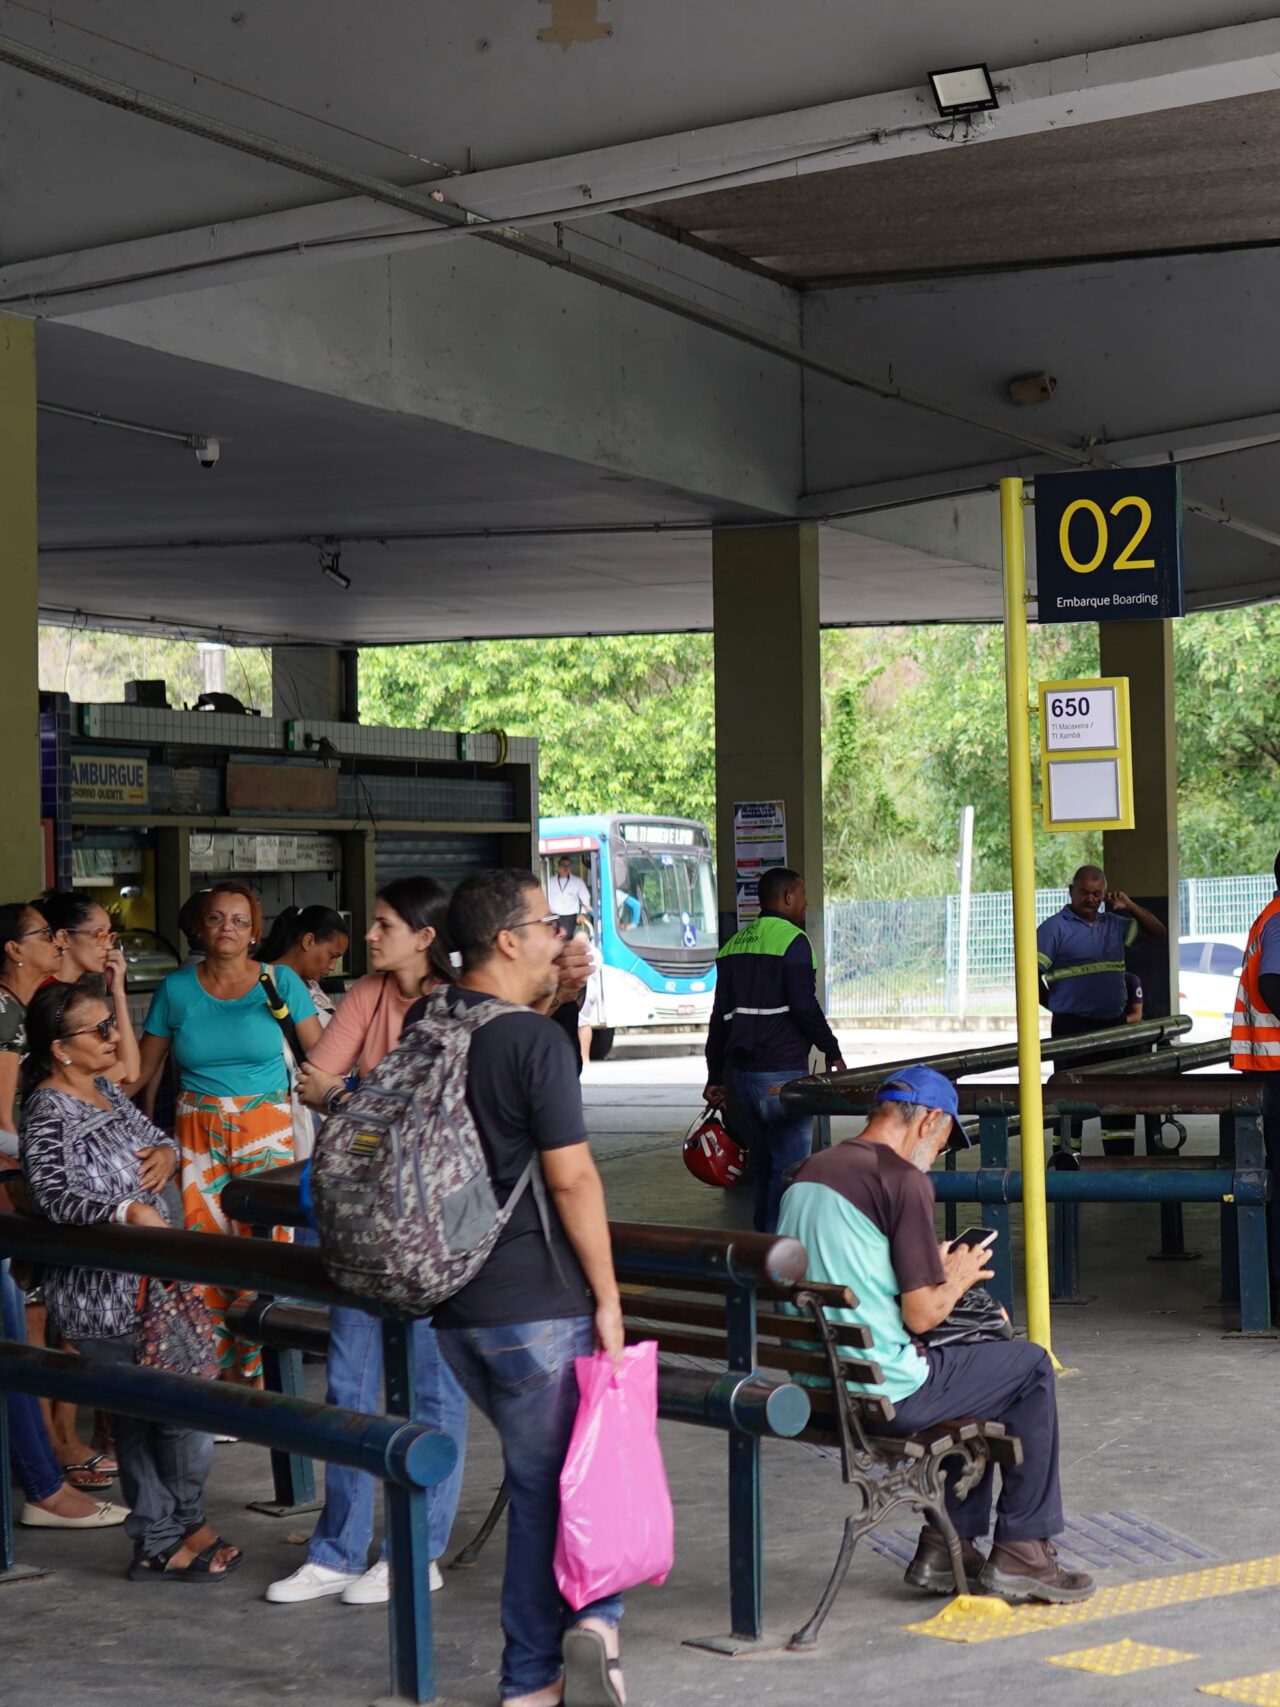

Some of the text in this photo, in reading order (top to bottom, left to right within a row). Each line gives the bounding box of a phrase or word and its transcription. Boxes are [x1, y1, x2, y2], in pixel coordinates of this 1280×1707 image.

[1059, 496, 1155, 573] 02
[1056, 593, 1159, 608] Embarque Boarding
[1051, 697, 1090, 718] 650
[1051, 723, 1058, 731] TI
[1059, 722, 1089, 730] Macaxeira
[1051, 732, 1058, 740] TI
[98, 789, 124, 801] QUENTE
